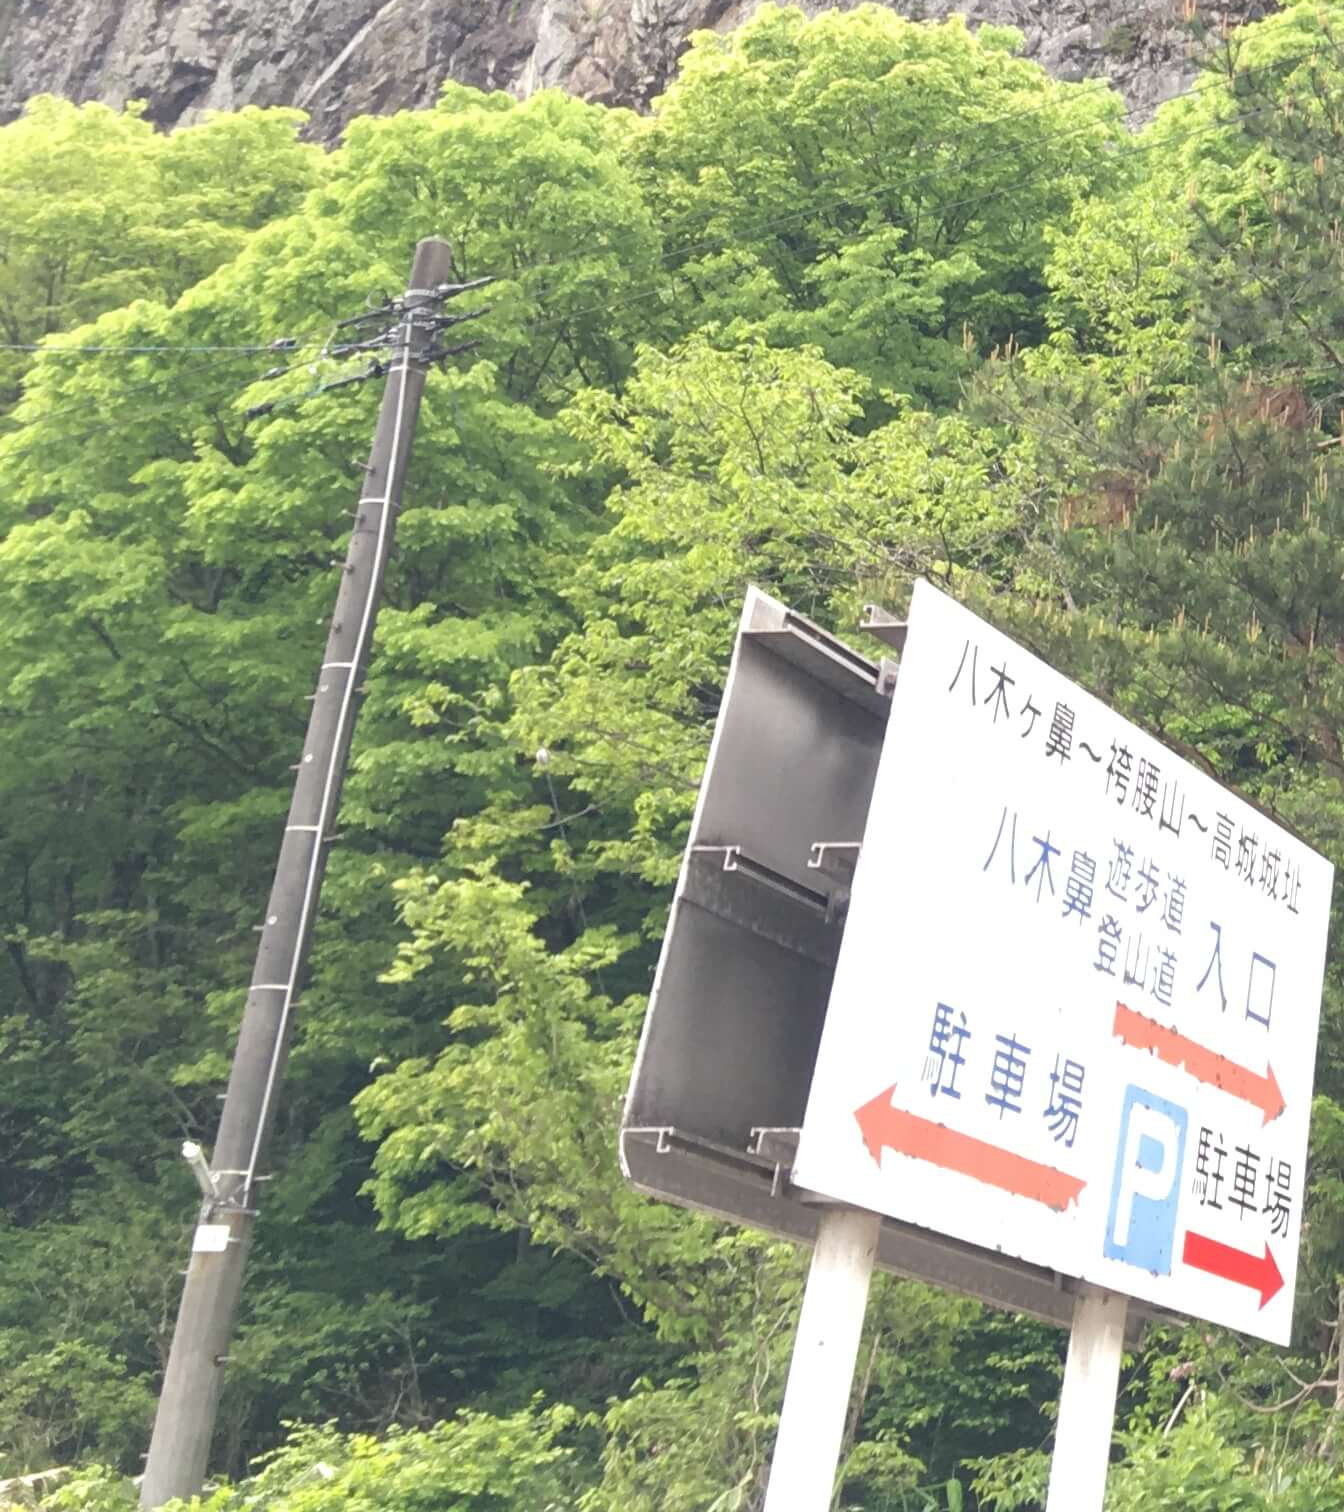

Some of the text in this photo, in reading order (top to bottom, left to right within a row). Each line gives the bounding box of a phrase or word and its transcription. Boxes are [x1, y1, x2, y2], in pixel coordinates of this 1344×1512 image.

[1093, 913, 1177, 1006] 登山道
[1196, 920, 1277, 1032] 入口
[921, 1001, 1086, 1148] 駐車場
[1113, 1101, 1181, 1247] P
[1191, 1126, 1292, 1239] 駐車場
